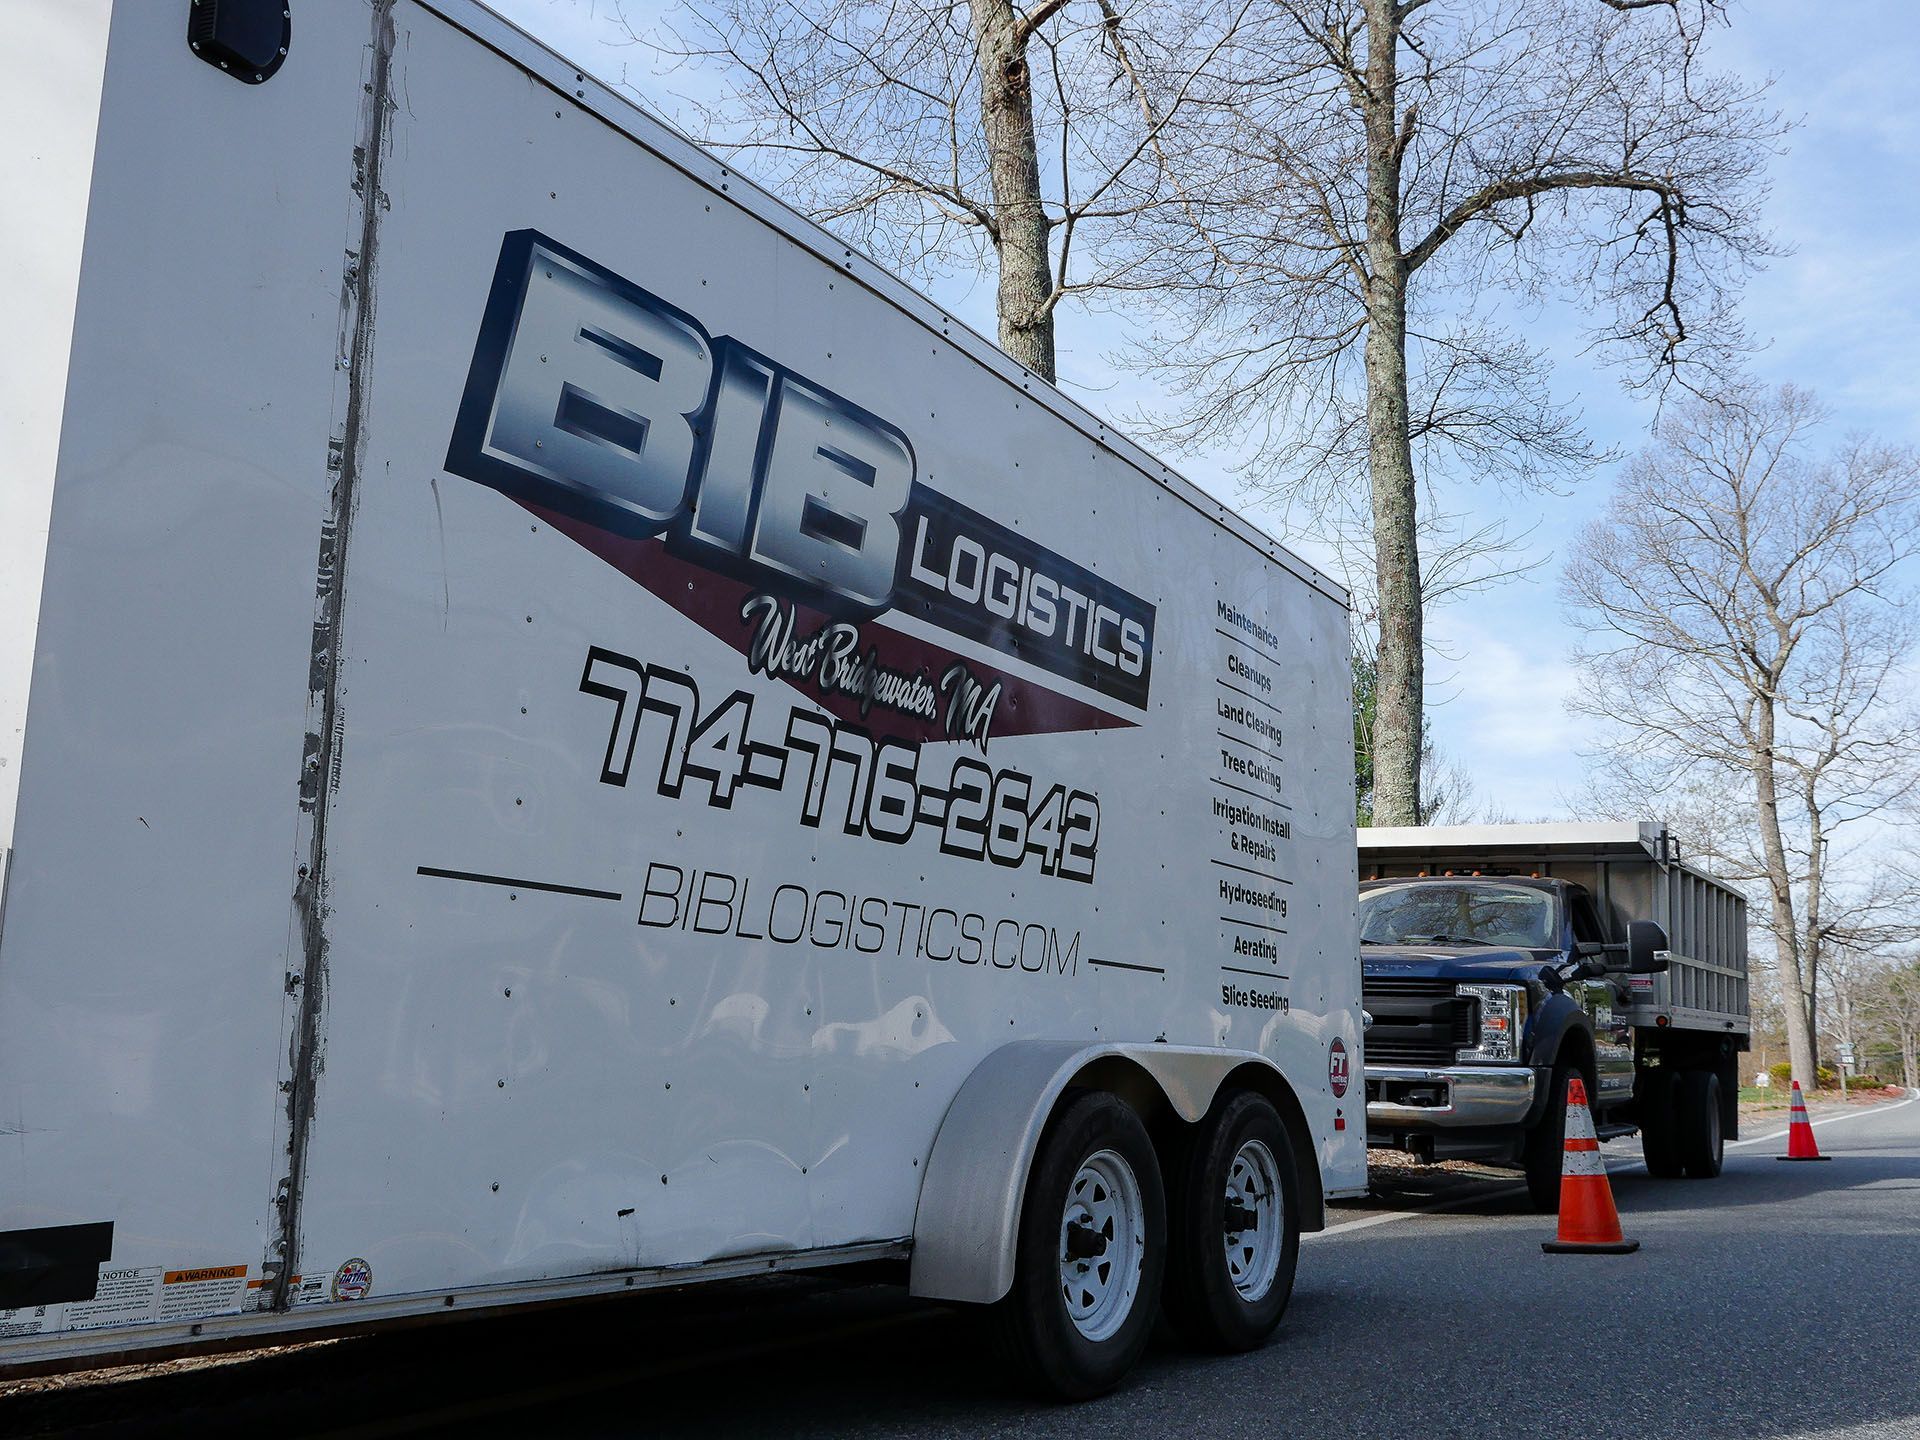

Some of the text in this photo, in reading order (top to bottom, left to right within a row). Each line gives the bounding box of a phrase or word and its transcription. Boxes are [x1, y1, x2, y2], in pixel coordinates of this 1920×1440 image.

[464, 231, 918, 616] BIB
[910, 514, 1147, 677] LOGISTICS
[1217, 599, 1279, 650] Maintenance
[742, 595, 817, 676] West
[940, 666, 1002, 751] MA
[1228, 654, 1272, 692] Cleanups
[1217, 698, 1282, 748] Land Clearing
[579, 645, 1100, 884] 774-776-2642
[1221, 750, 1282, 794] Tree Cutting
[1213, 797, 1290, 840] Irrigation Install
[1231, 832, 1276, 863] & Repairs
[637, 862, 1080, 977] BIBLOGISTICS.COM
[1219, 879, 1287, 918] Hydroseeding
[1233, 935, 1277, 965] Aerating
[1222, 984, 1289, 1016] Slice Seeding
[1330, 1052, 1346, 1074] FT
[103, 1270, 139, 1280] NOTICE
[185, 1267, 236, 1280] WARNING
